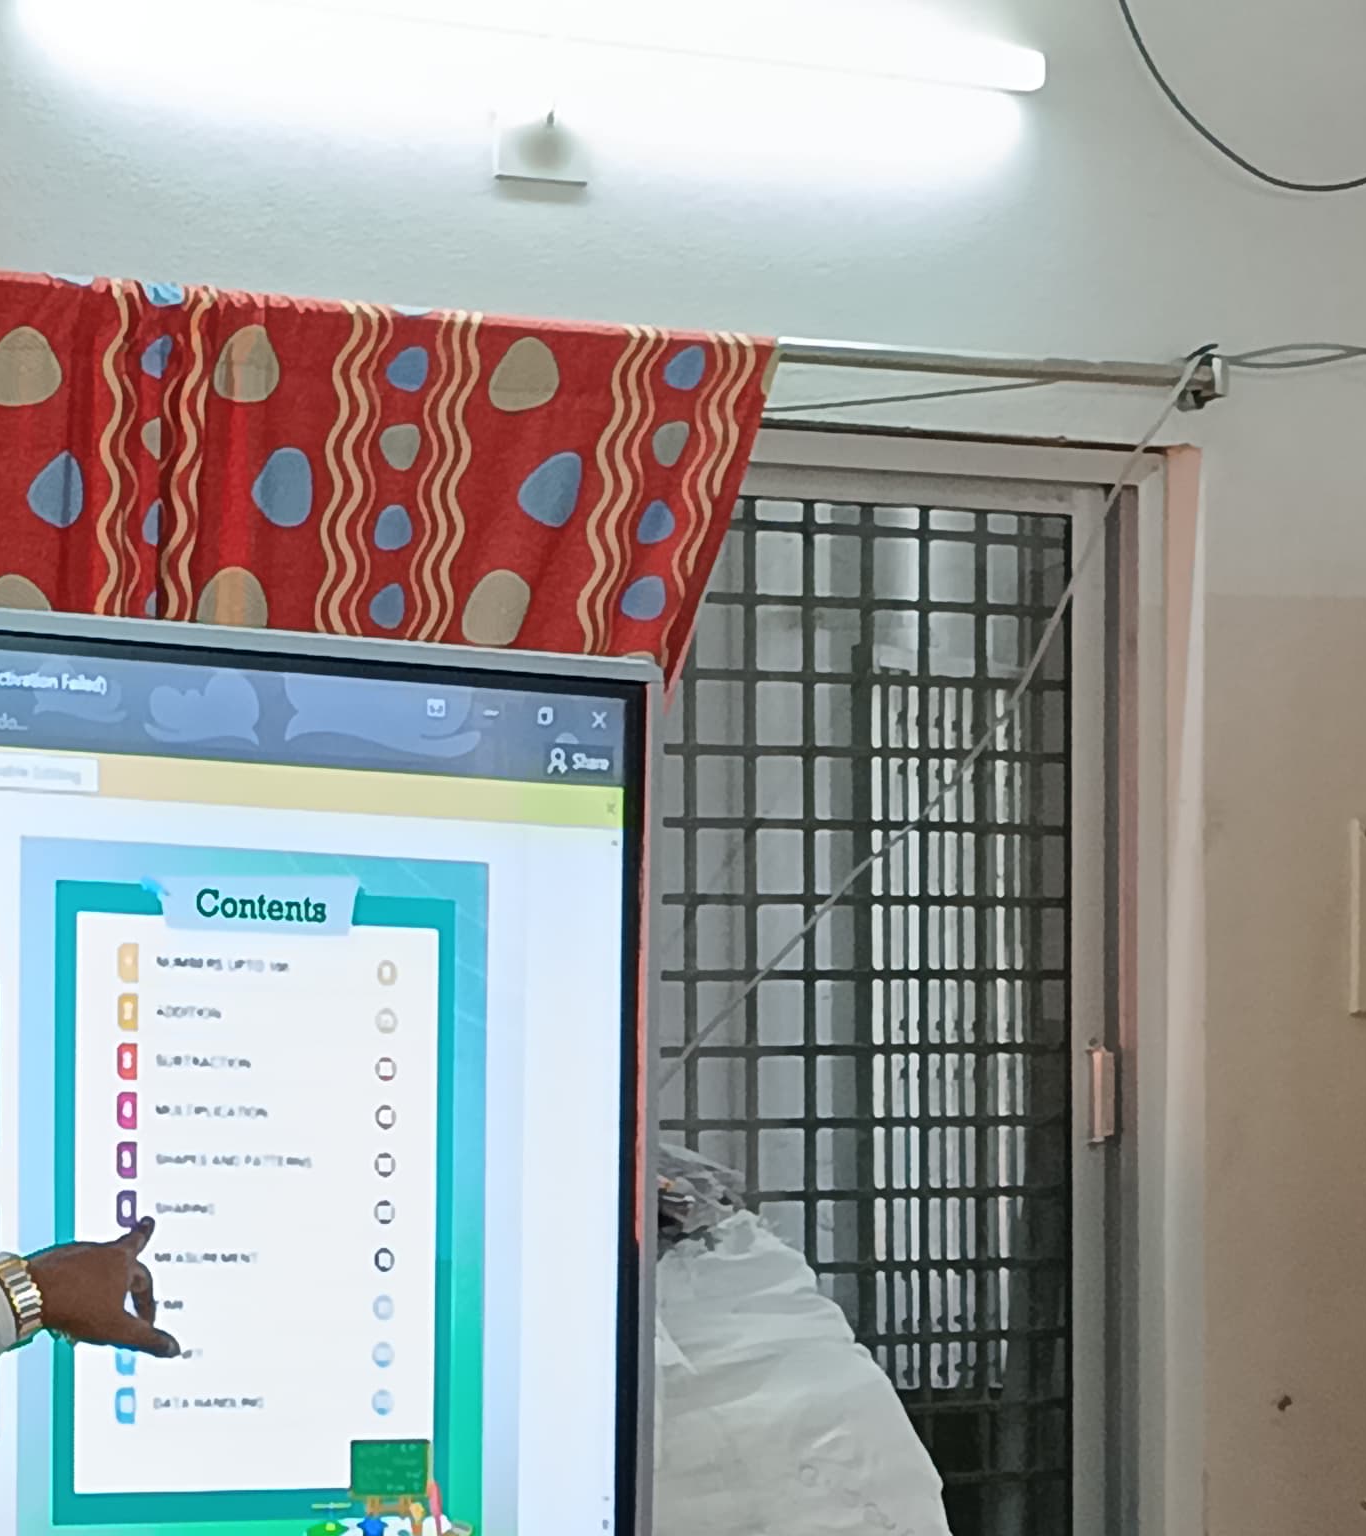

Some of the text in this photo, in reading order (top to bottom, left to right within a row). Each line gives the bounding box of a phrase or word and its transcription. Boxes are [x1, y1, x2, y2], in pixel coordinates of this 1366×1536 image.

[61, 673, 108, 695] Failed)
[571, 752, 611, 771] Share
[195, 887, 328, 924] Contents
